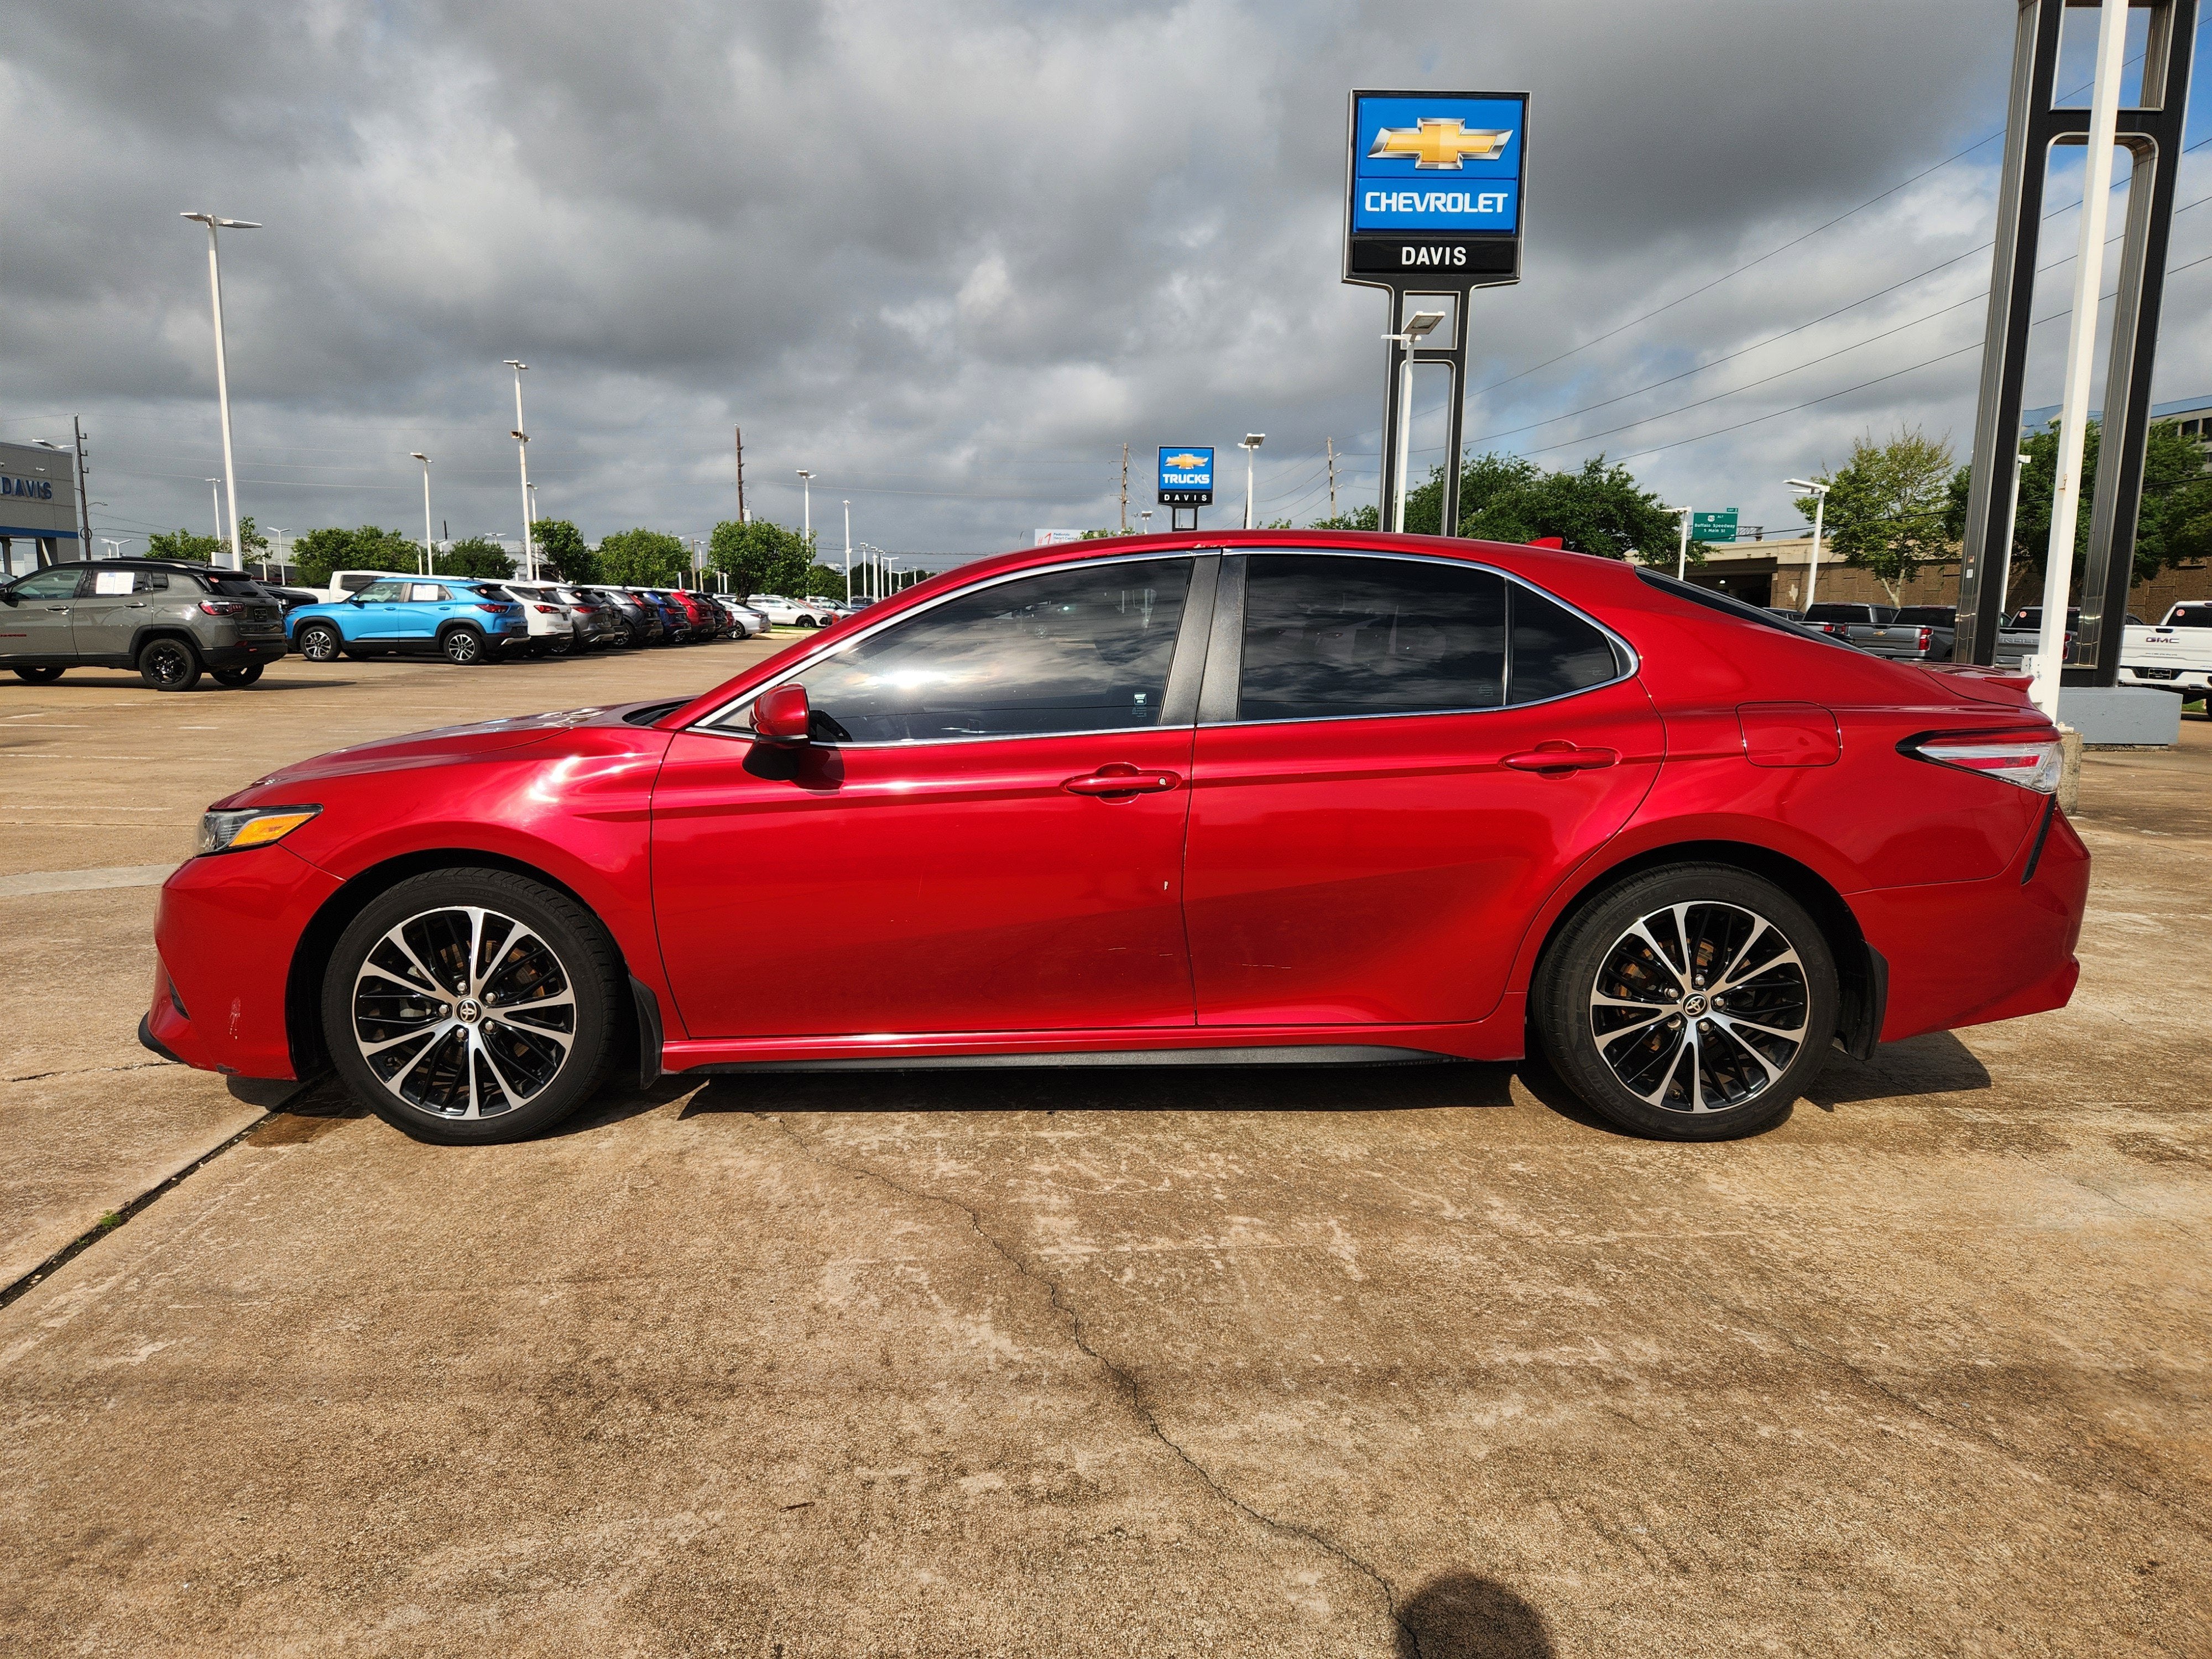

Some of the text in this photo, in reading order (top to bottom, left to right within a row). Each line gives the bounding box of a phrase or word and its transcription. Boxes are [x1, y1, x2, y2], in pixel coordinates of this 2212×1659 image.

[1365, 191, 1509, 213] CHEVROLET
[1401, 247, 1467, 265] DAVIS
[1, 477, 52, 499] DAVIS
[1162, 473, 1210, 484] TRUCKS
